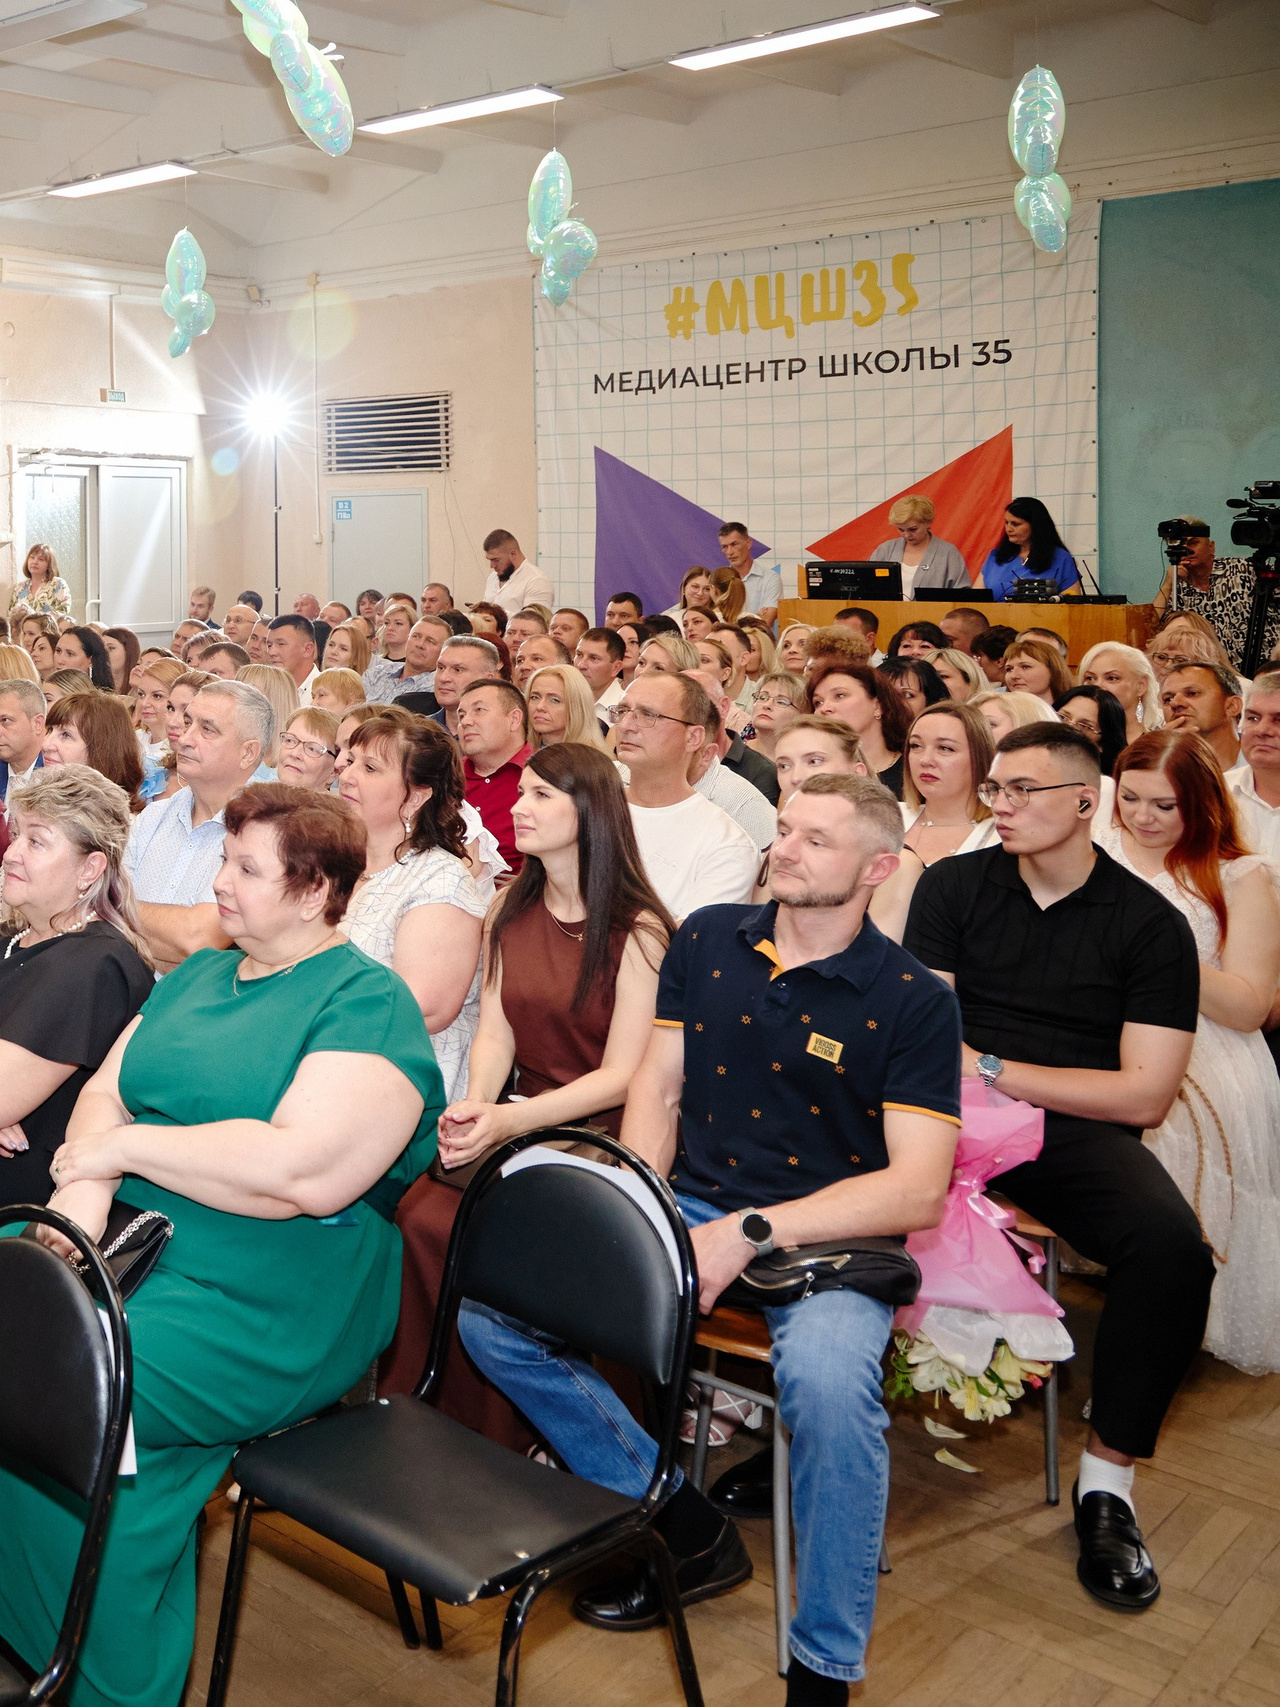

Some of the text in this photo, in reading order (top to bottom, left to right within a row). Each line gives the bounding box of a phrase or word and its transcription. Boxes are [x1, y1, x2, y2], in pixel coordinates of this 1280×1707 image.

[664, 253, 919, 340] #МЦШ35
[593, 339, 1013, 396] МЕДИАЦЕНТР ШКОЛЫ 35
[812, 1044, 835, 1059] ACTION
